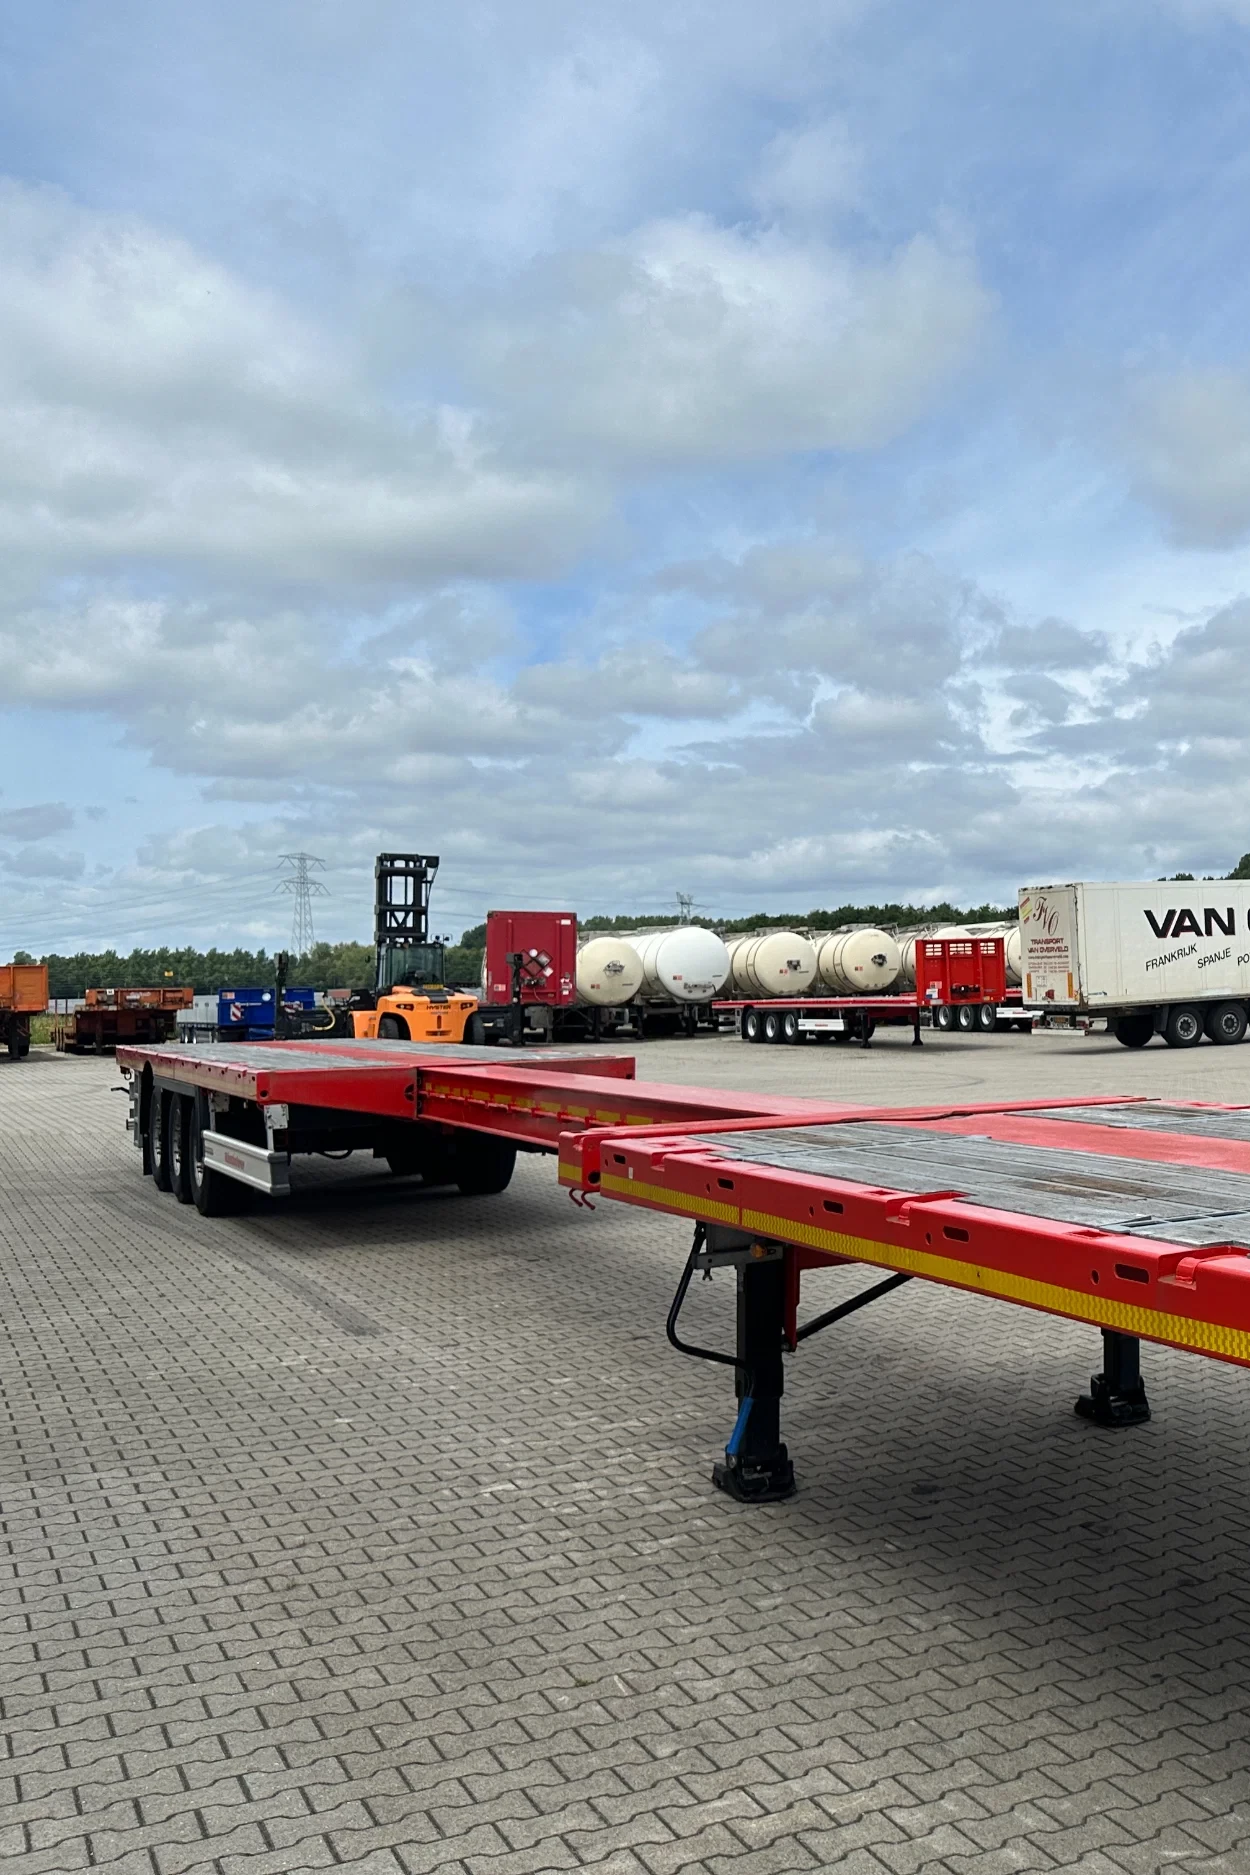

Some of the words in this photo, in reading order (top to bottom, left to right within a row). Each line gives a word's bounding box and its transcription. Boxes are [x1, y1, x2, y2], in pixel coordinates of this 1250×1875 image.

[1143, 907, 1236, 939] VAN
[1030, 937, 1064, 945] TRANSPORT
[1040, 945, 1069, 954] OVERVELD
[1145, 942, 1198, 972] FRANKRIJK
[1197, 947, 1232, 969] SPANJE
